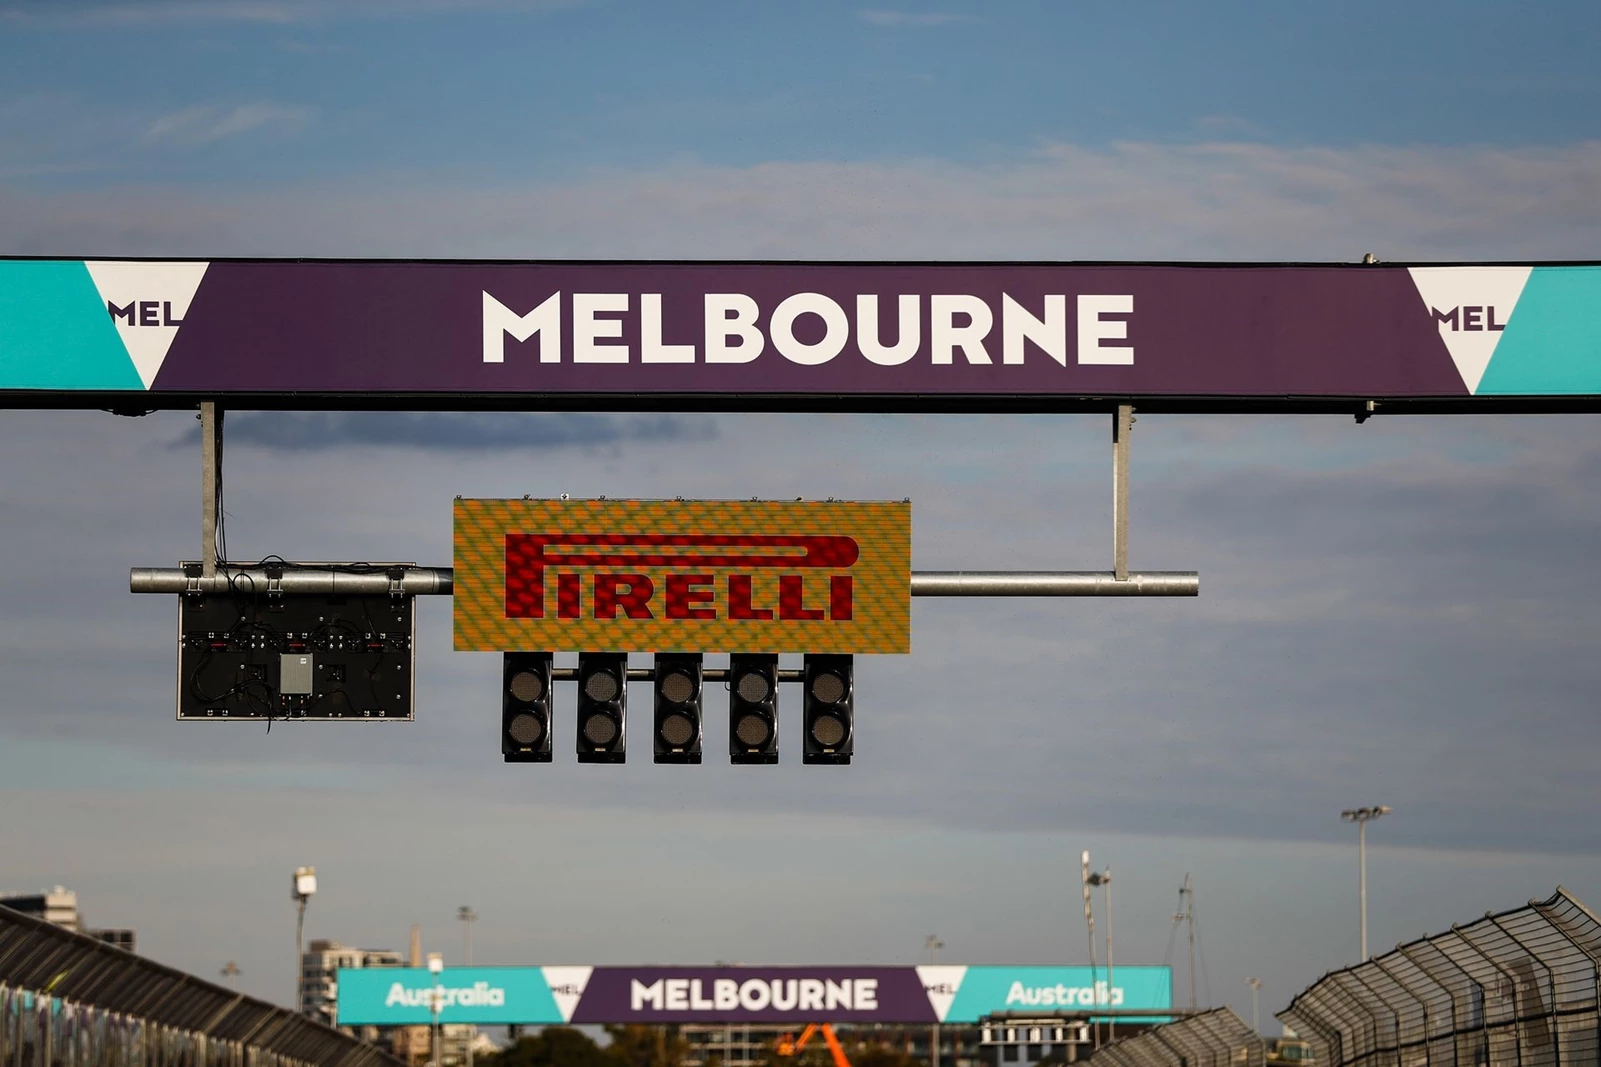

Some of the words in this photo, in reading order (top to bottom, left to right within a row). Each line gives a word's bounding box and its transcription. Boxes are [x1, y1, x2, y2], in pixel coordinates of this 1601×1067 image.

[107, 300, 183, 327] MEL
[1430, 305, 1506, 332] MEL
[482, 290, 1134, 367] MELBOURNE
[505, 533, 860, 621] PIRELLI
[385, 981, 505, 1007] Australia
[631, 978, 878, 1011] MELBOURNE
[1005, 980, 1124, 1006] Australia
